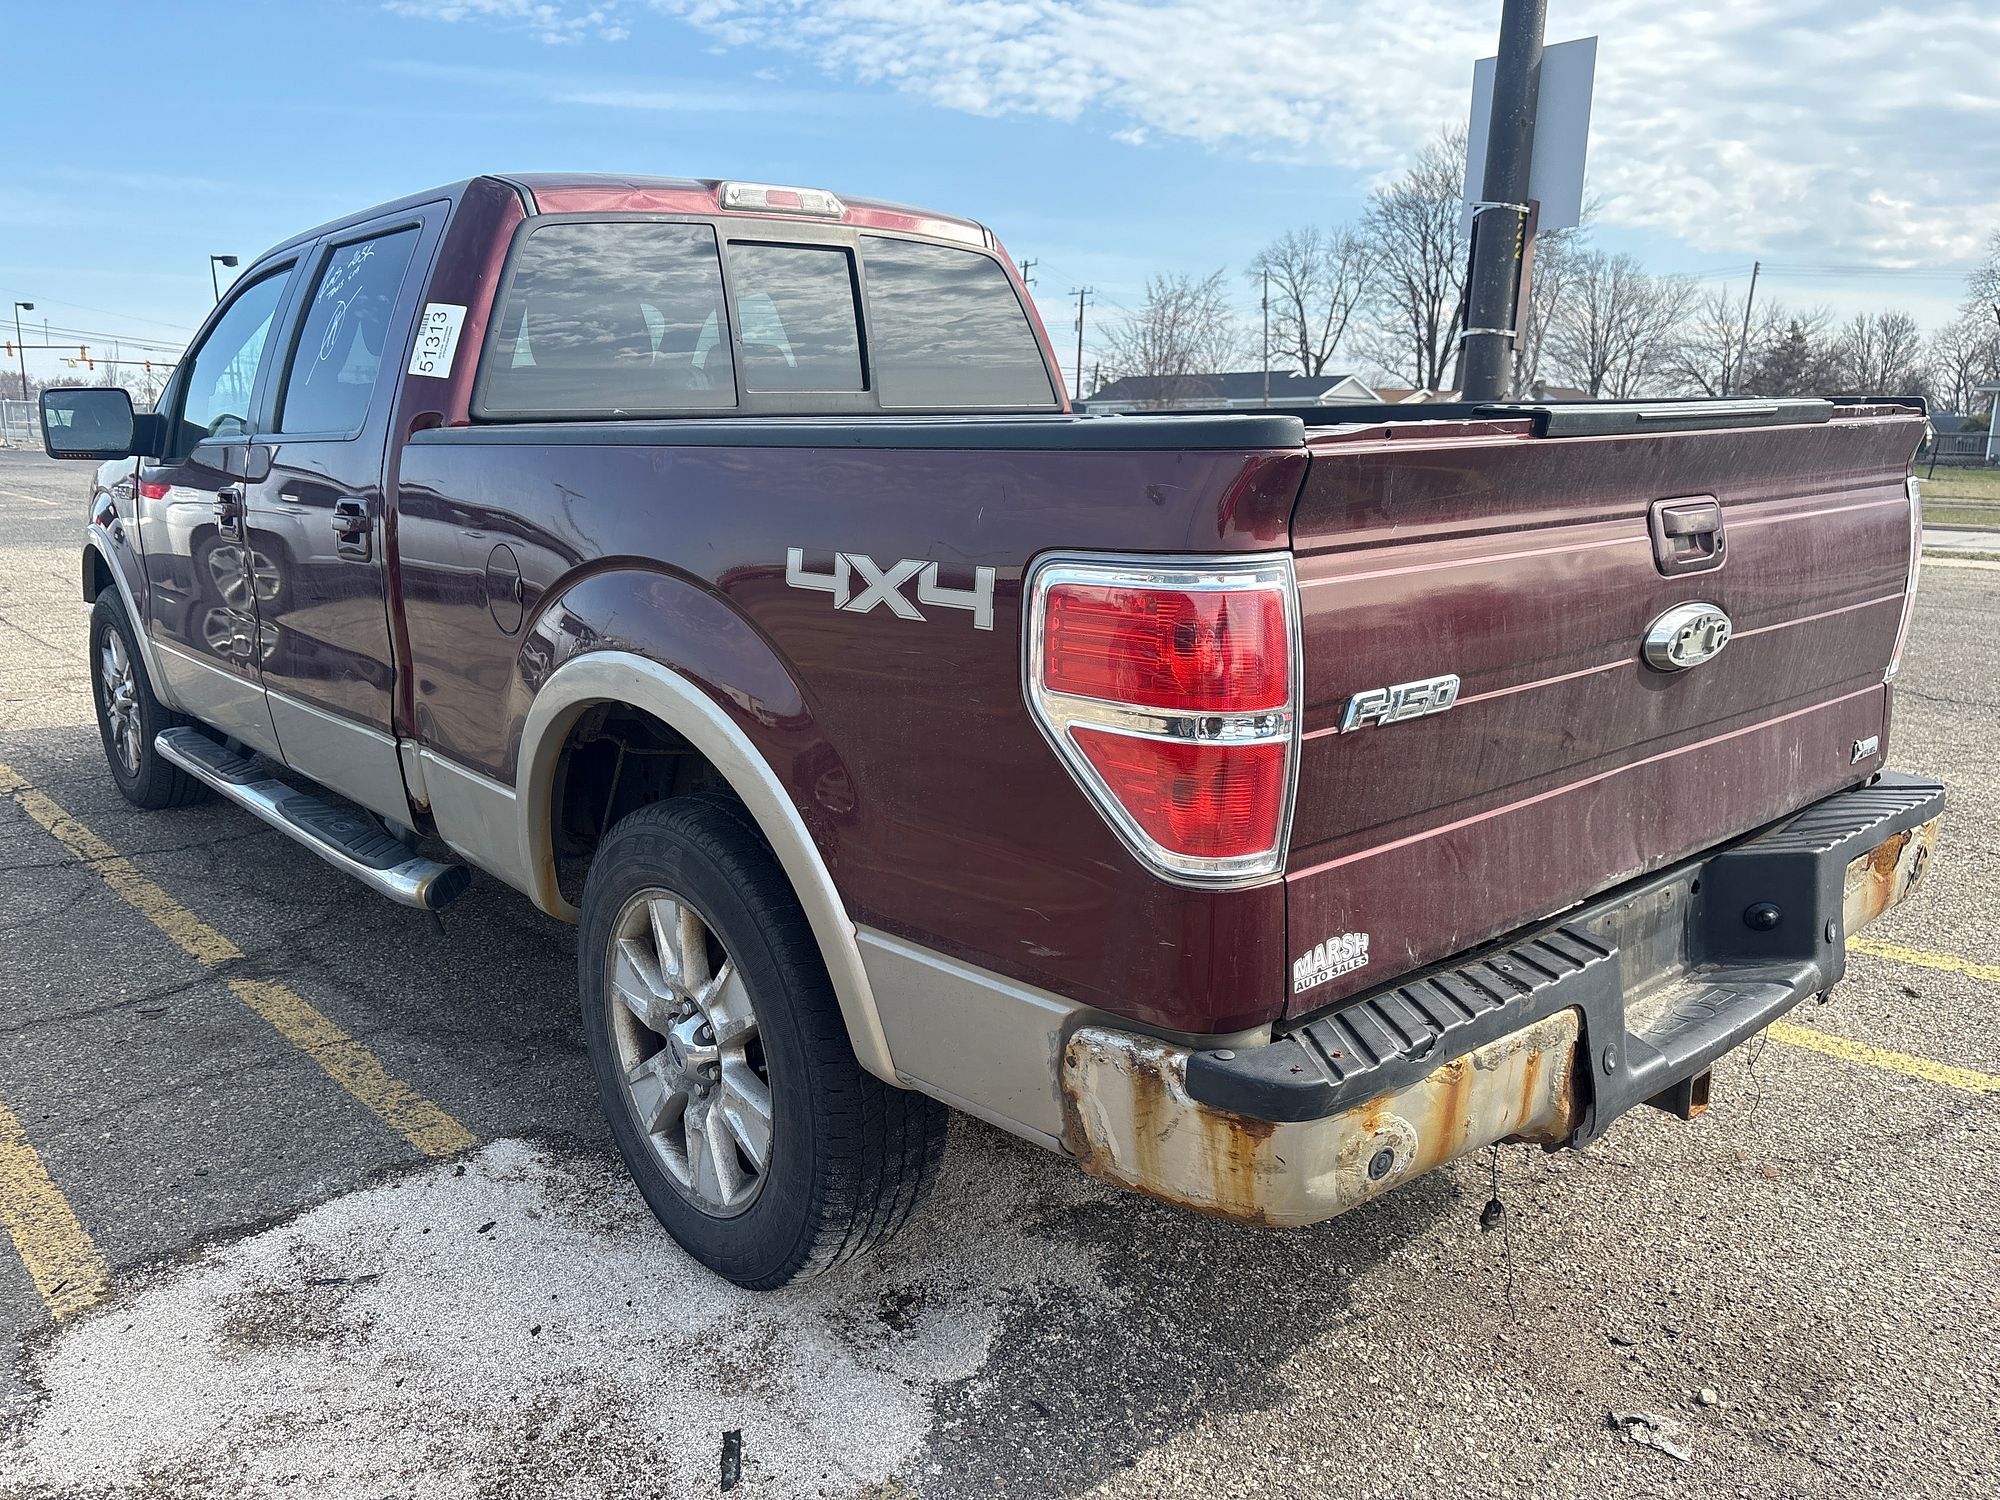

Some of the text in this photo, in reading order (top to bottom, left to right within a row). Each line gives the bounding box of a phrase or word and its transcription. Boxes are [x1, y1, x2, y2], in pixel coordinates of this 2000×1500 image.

[419, 312, 447, 373] 51313
[1340, 673, 1461, 735] F-150
[1293, 932, 1370, 982] MARSH
[1296, 956, 1367, 992] AUTO SALES
